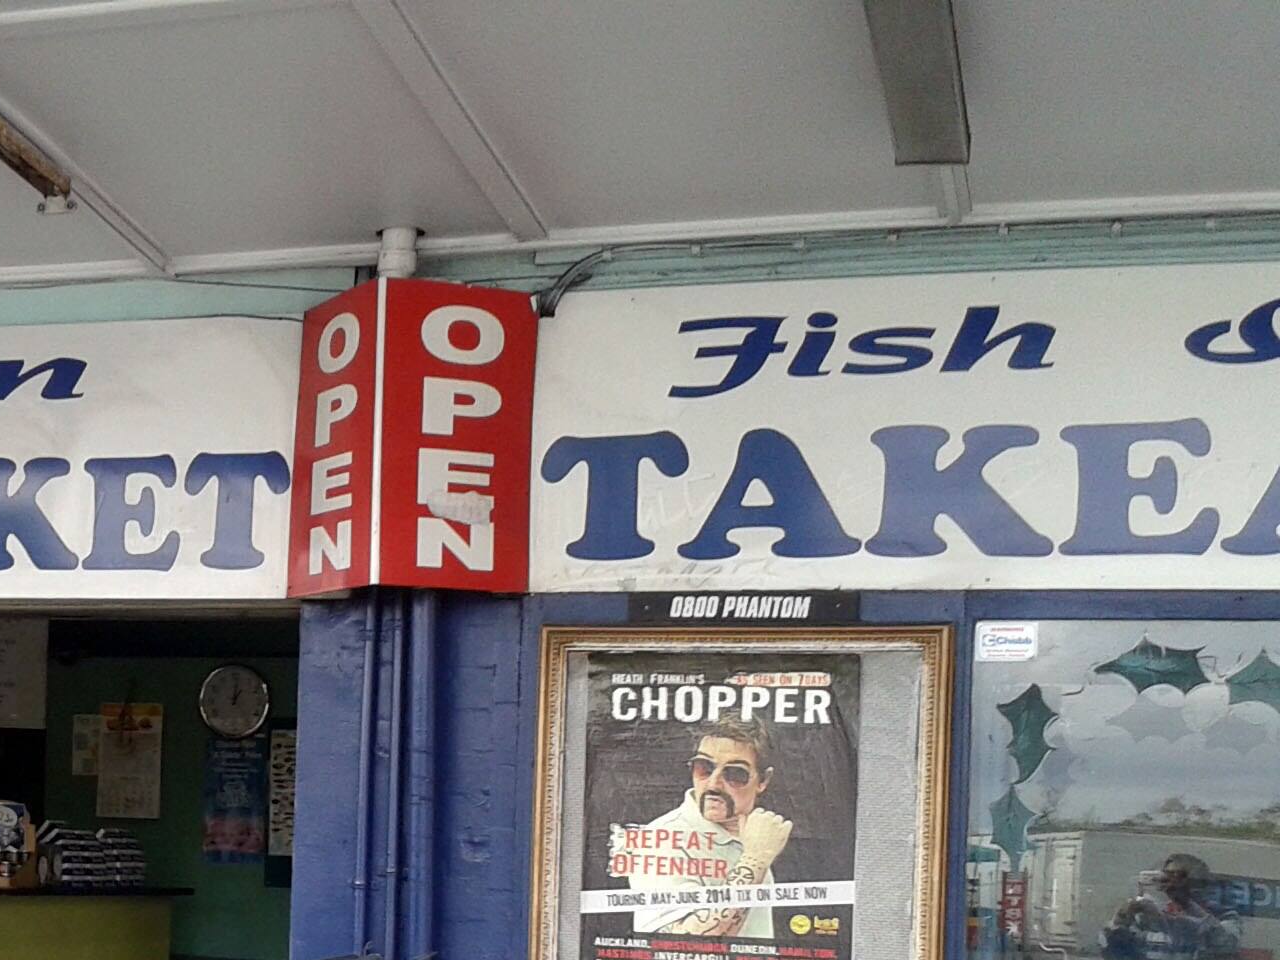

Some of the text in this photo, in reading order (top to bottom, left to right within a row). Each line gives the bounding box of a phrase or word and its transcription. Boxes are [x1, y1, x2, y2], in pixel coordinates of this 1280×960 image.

[668, 305, 1057, 397] Fish
[309, 312, 360, 576] OPEN
[416, 305, 505, 571] OPEN
[670, 595, 812, 619] 0800 PHANTOM
[612, 673, 643, 684] HEATH
[612, 686, 831, 724] CHOPPER
[625, 829, 717, 850] REPEAT
[611, 854, 728, 878] OFFENDER
[607, 894, 646, 906] TOURING
[706, 888, 731, 903] 2014
[757, 888, 770, 901] ON
[776, 888, 799, 900] SALE
[805, 886, 828, 899] NOW
